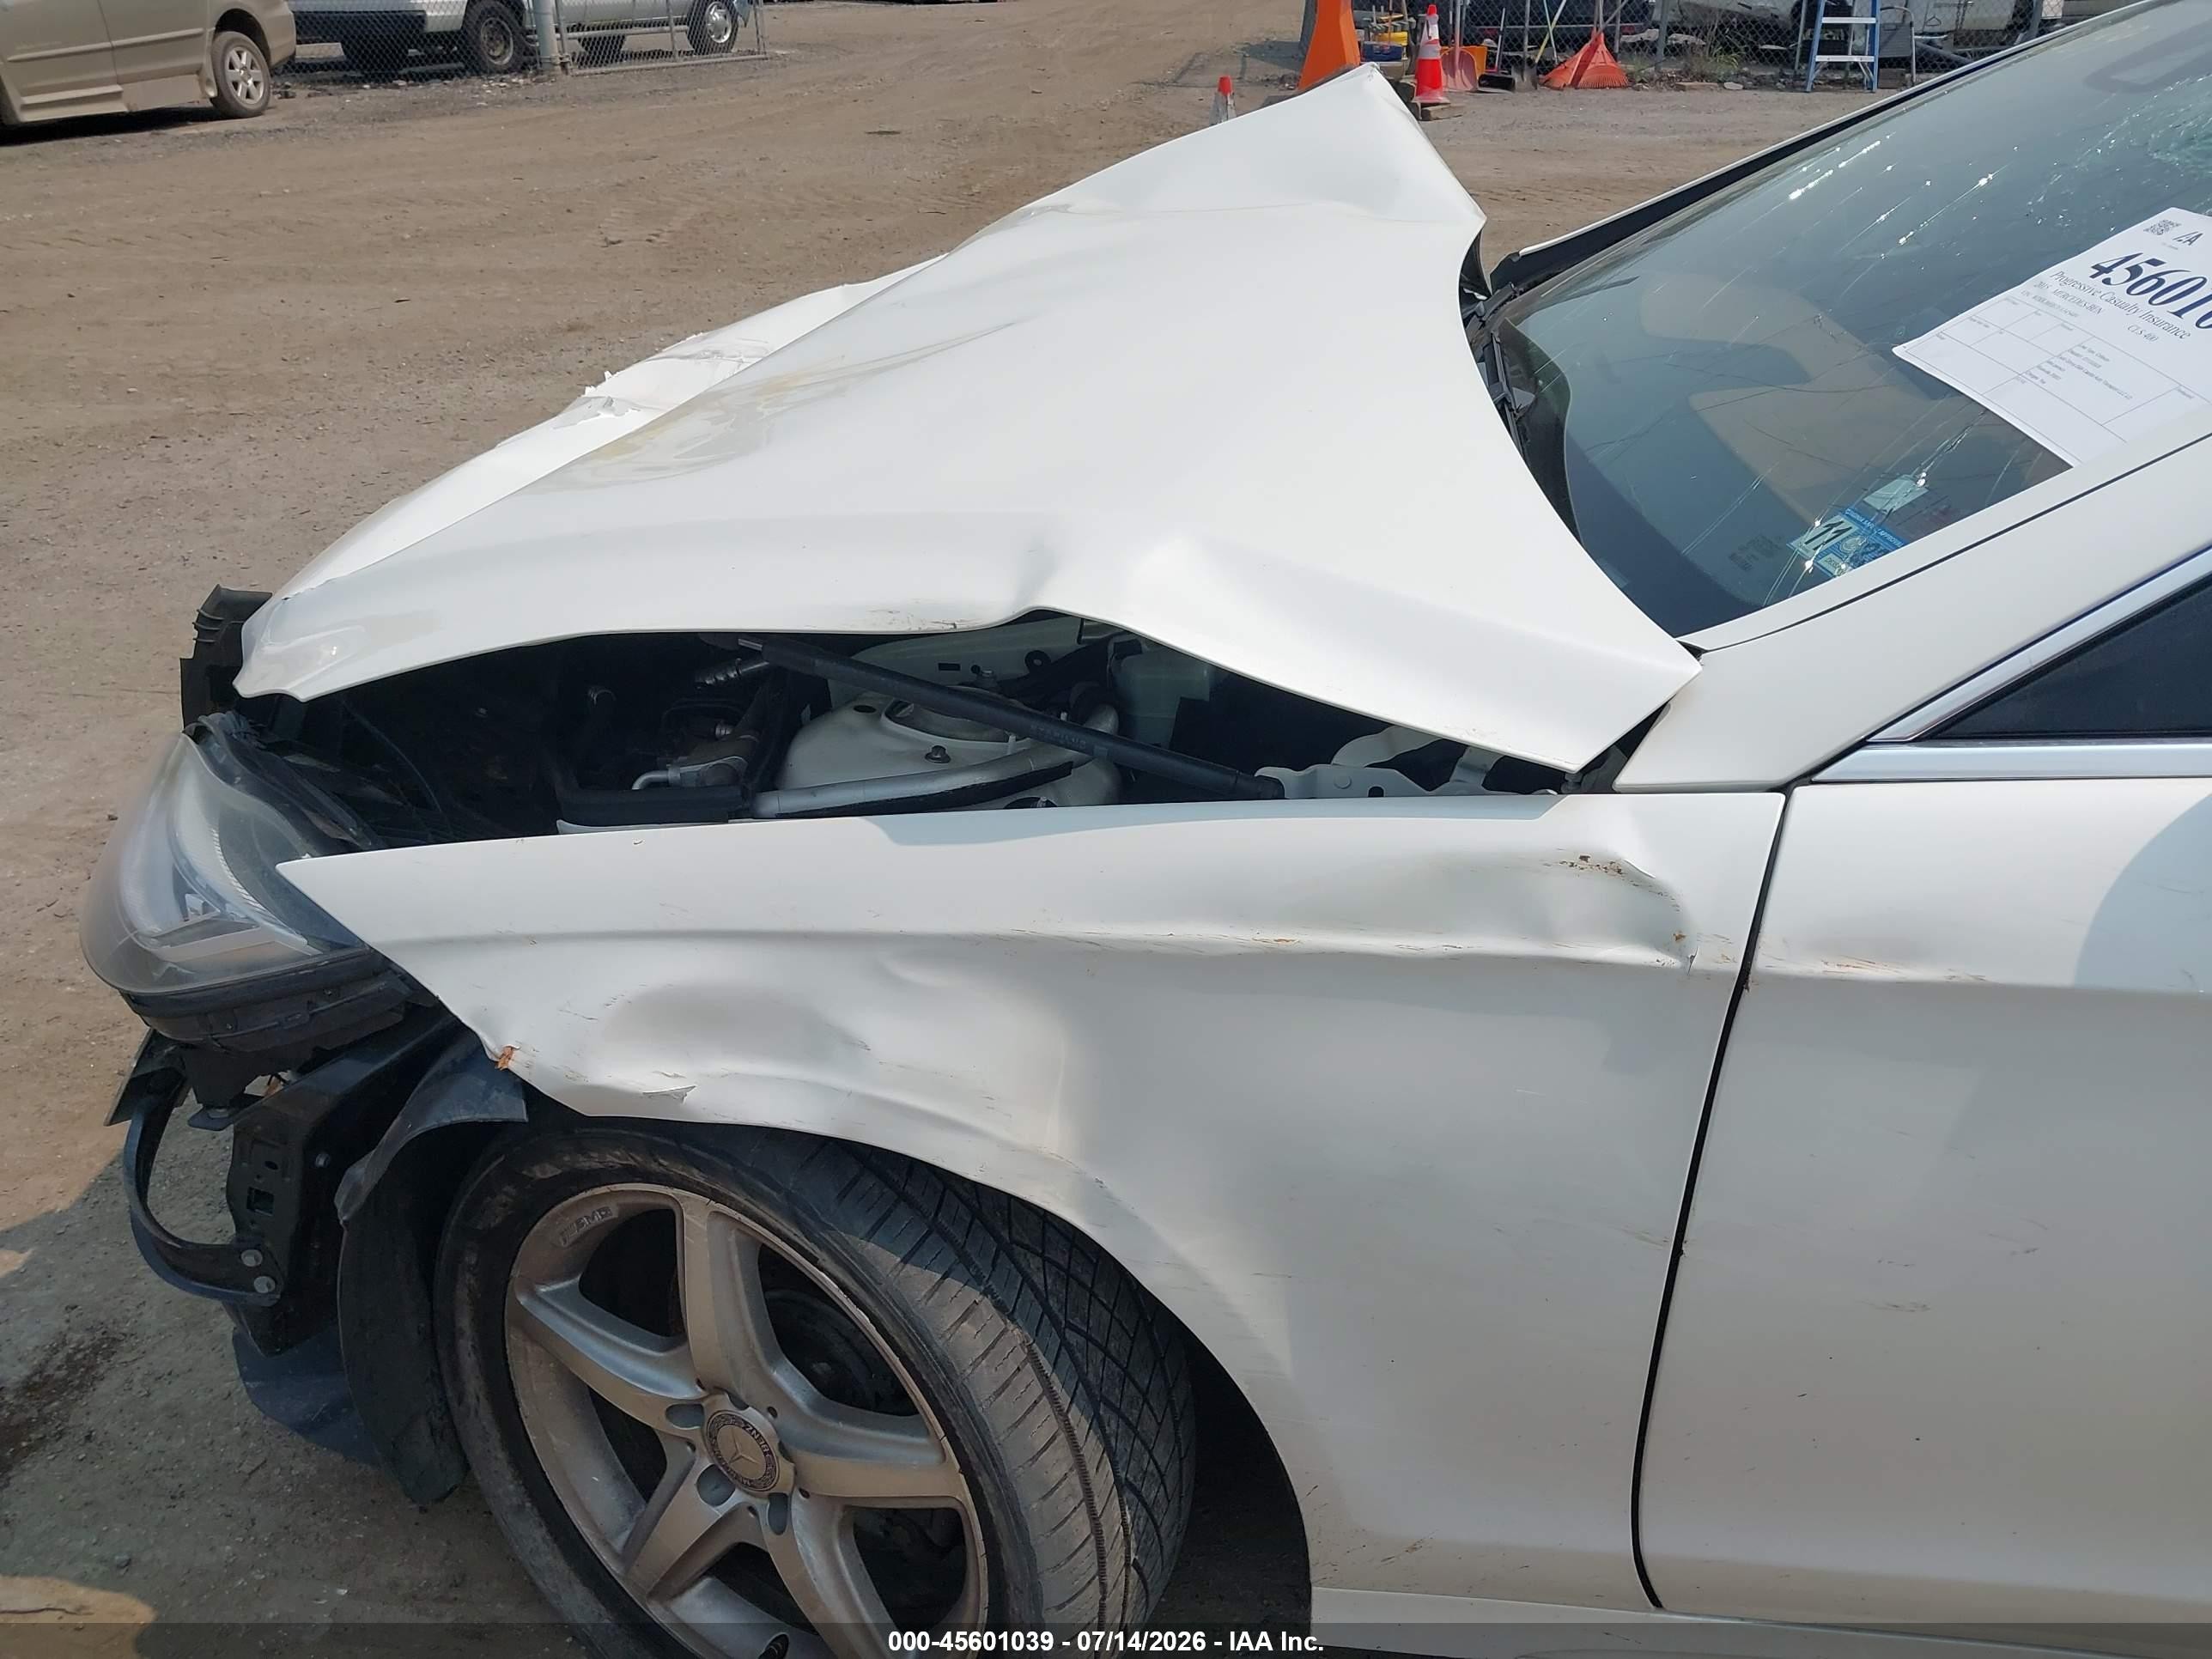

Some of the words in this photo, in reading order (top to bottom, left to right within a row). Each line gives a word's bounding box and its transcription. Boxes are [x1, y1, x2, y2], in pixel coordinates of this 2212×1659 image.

[2050, 270, 2101, 296] Progressive
[2099, 291, 2142, 316] Casualty
[2138, 310, 2191, 339] Insurance
[742, 1423, 770, 1452] BENZ
